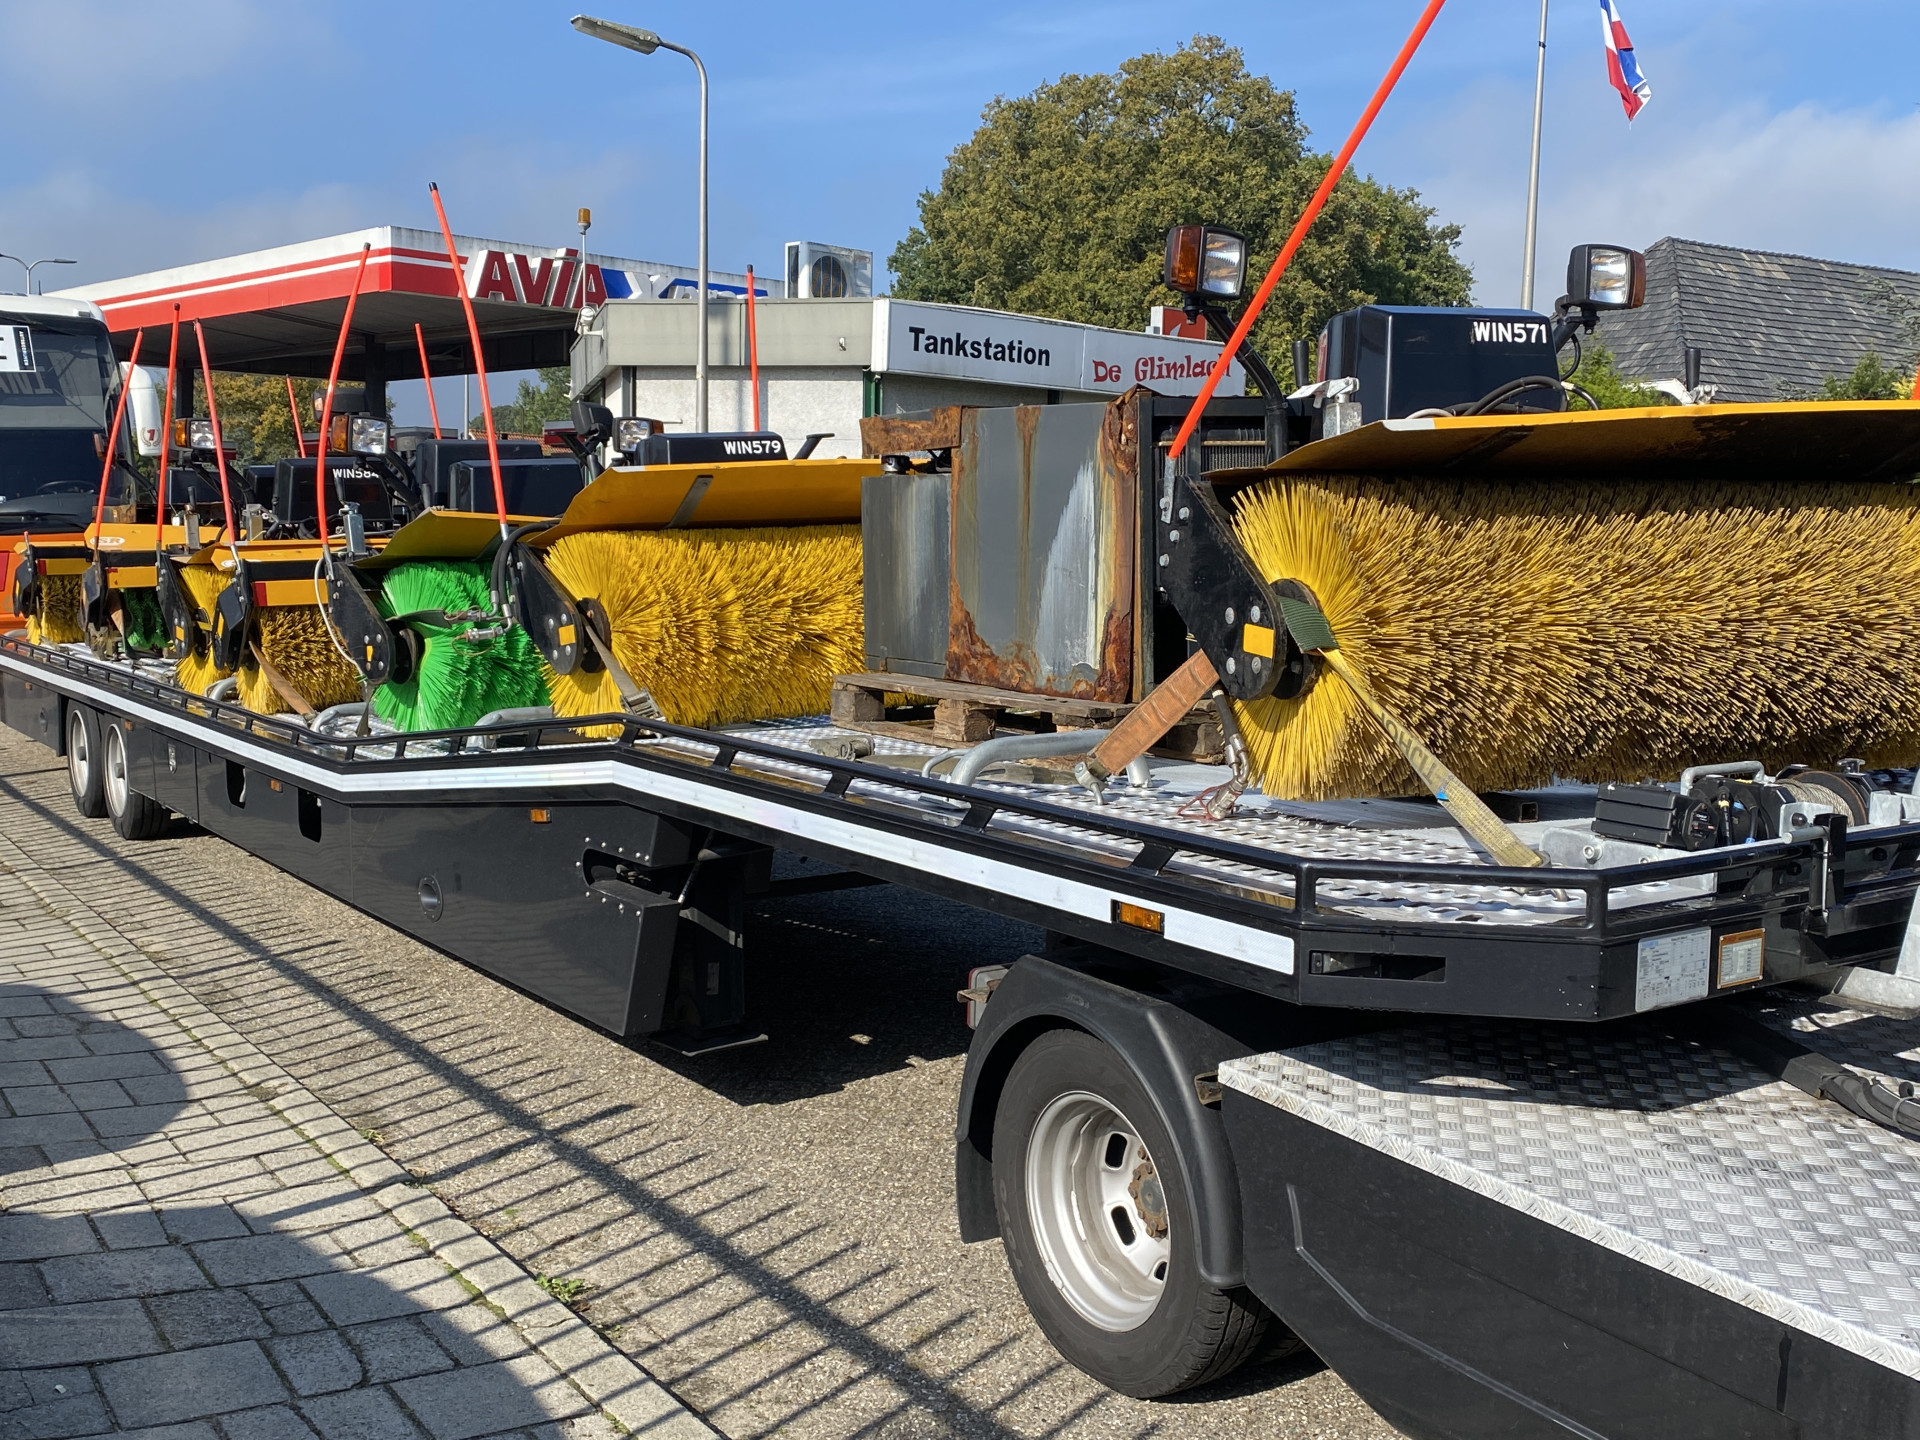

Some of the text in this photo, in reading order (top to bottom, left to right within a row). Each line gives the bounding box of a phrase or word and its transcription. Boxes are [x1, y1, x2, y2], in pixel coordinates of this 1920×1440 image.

[1473, 321, 1547, 344] WIN571
[908, 326, 1051, 366] Tankstation
[1092, 359, 1122, 382] De
[147, 428, 156, 441] 1
[723, 440, 781, 455] WIN579
